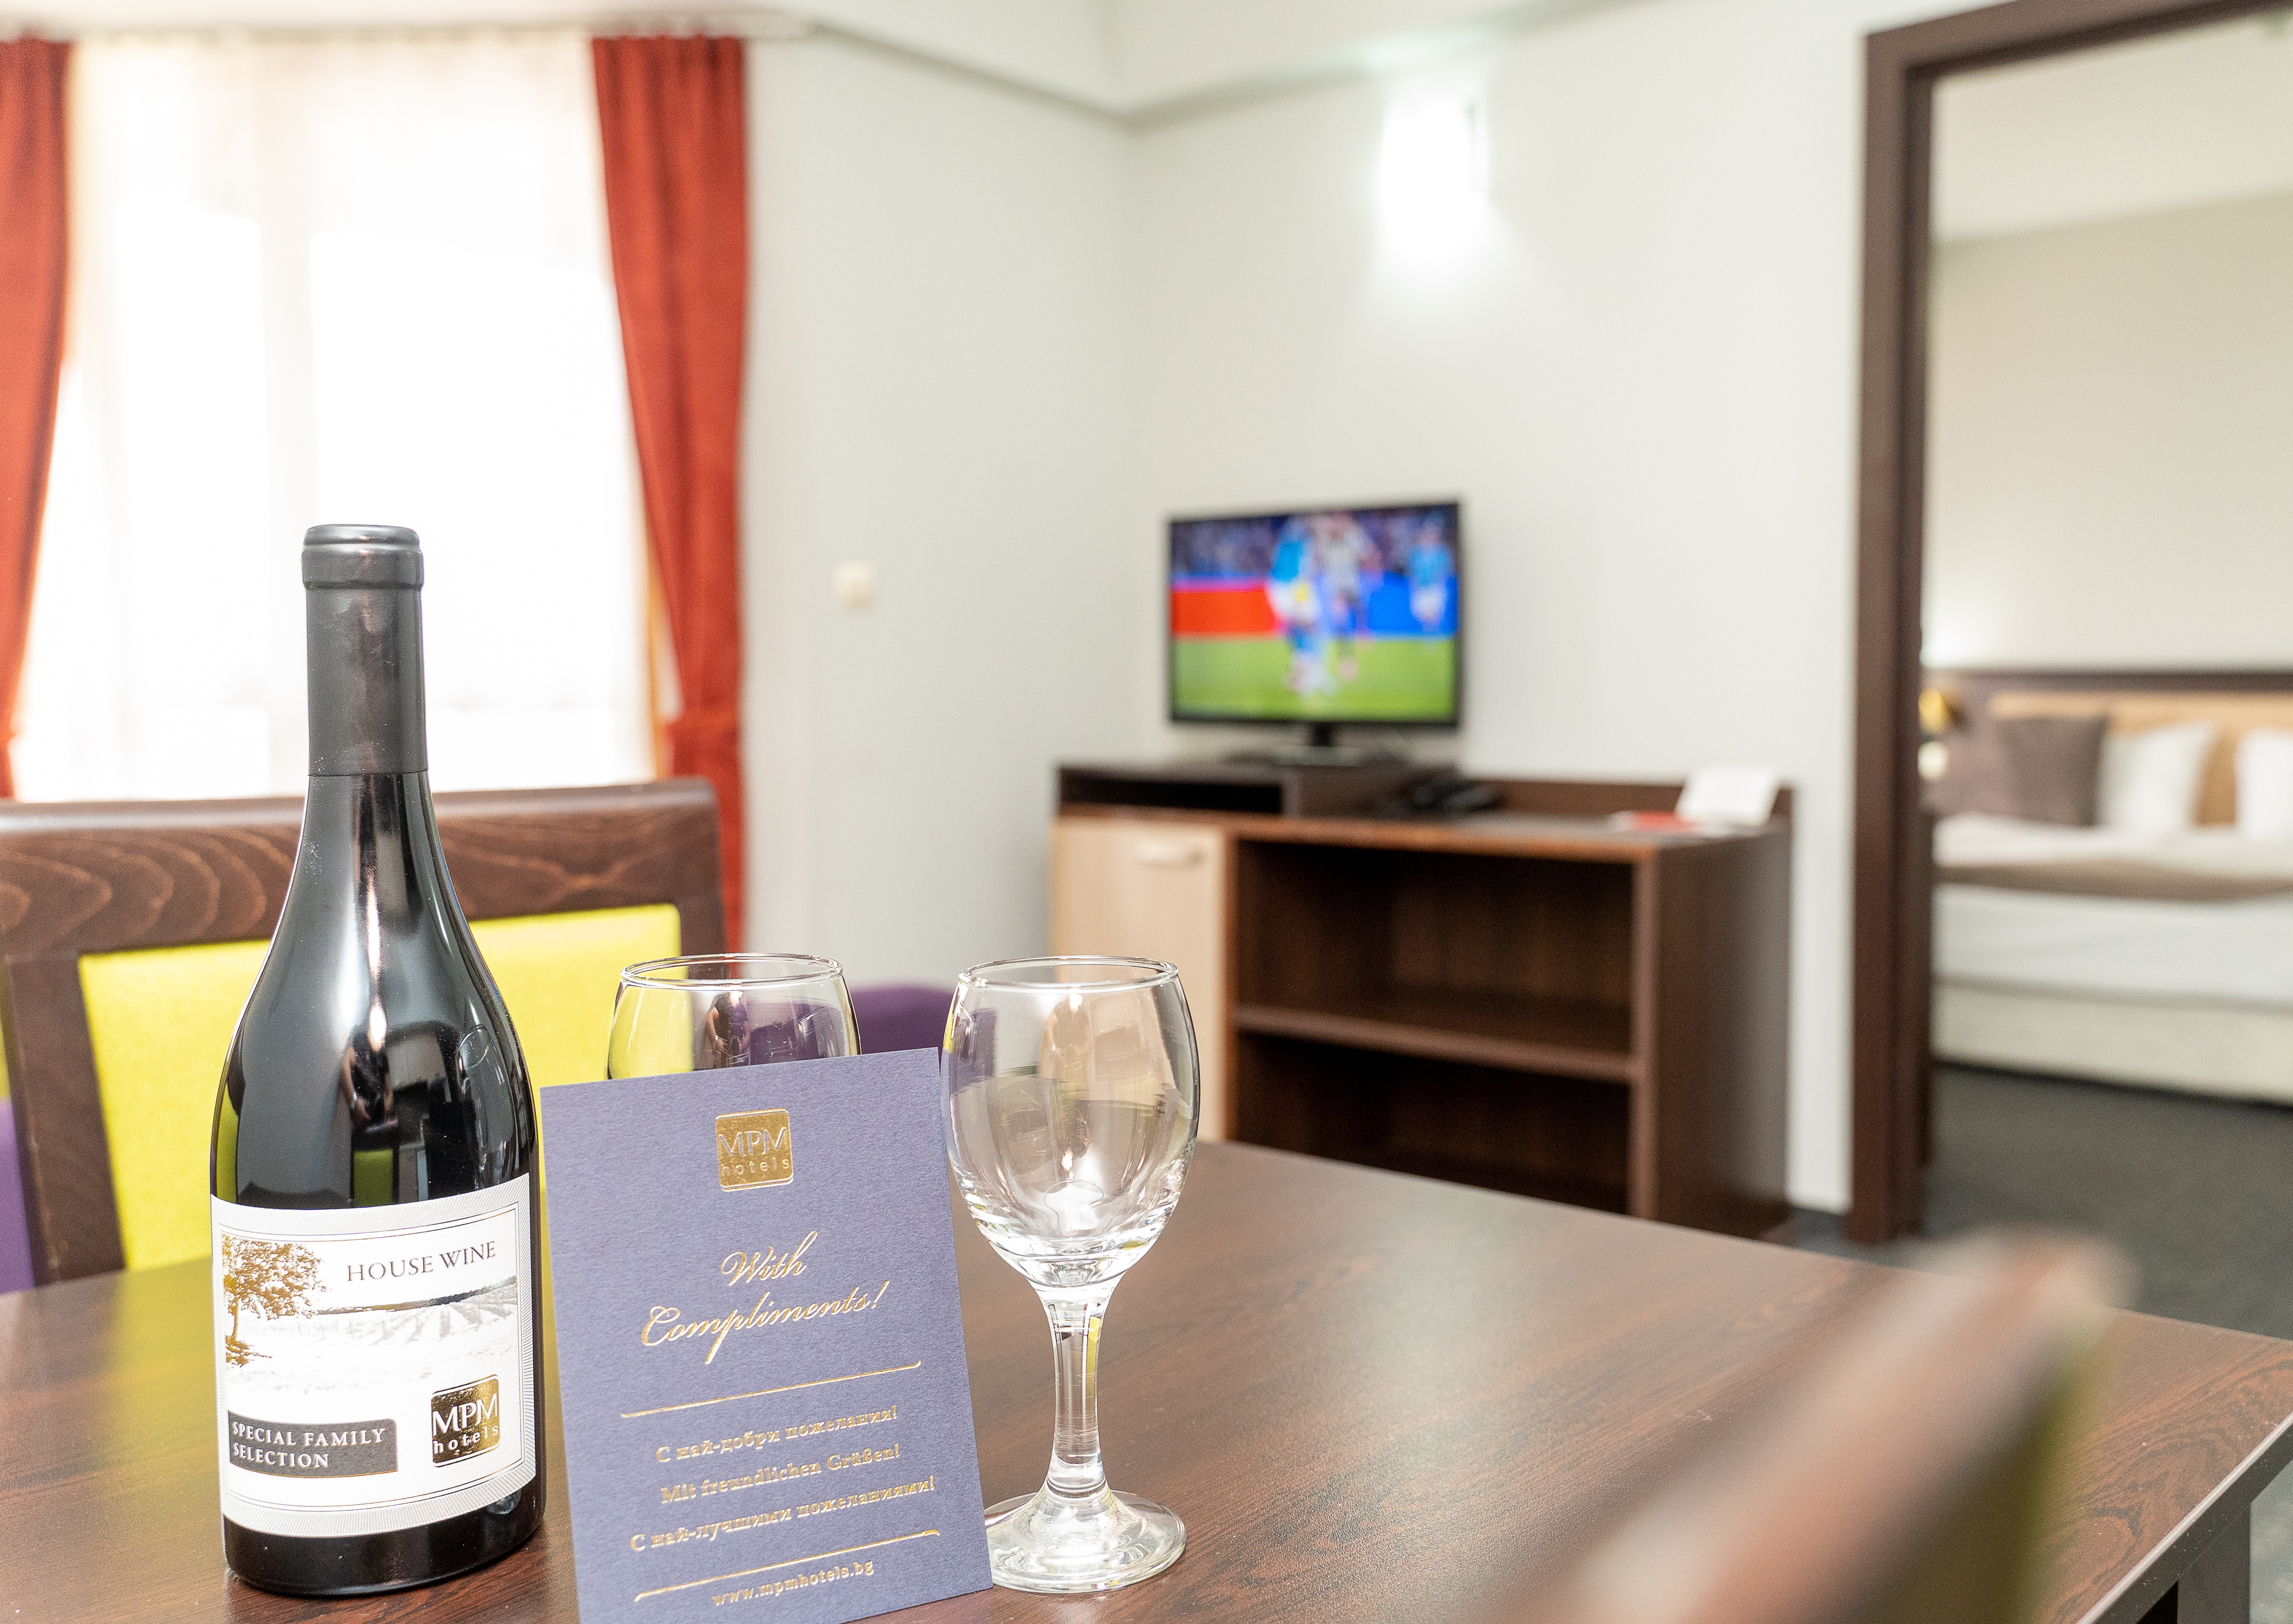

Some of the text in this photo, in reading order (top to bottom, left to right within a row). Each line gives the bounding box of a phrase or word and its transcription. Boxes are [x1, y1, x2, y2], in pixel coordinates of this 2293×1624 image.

[717, 1126, 786, 1159] MPM
[720, 1156, 791, 1177] hotels
[347, 1241, 496, 1282] HOUSE WINE
[720, 1230, 818, 1287] With
[641, 1280, 890, 1365] Compliments!
[232, 1421, 386, 1447] SPECIAL FAMILY
[432, 1393, 498, 1436] MPM
[676, 1428, 780, 1460] най-добри
[785, 1405, 897, 1440] пожелания!
[233, 1442, 329, 1468] SELECTION
[433, 1424, 499, 1455] hotels
[661, 1443, 900, 1504] Mit freundlichen Grüßen!
[651, 1507, 792, 1548] най-лучшими
[796, 1475, 934, 1519] пожеланиями!
[712, 1561, 874, 1606] www.mpmhotels.bg
